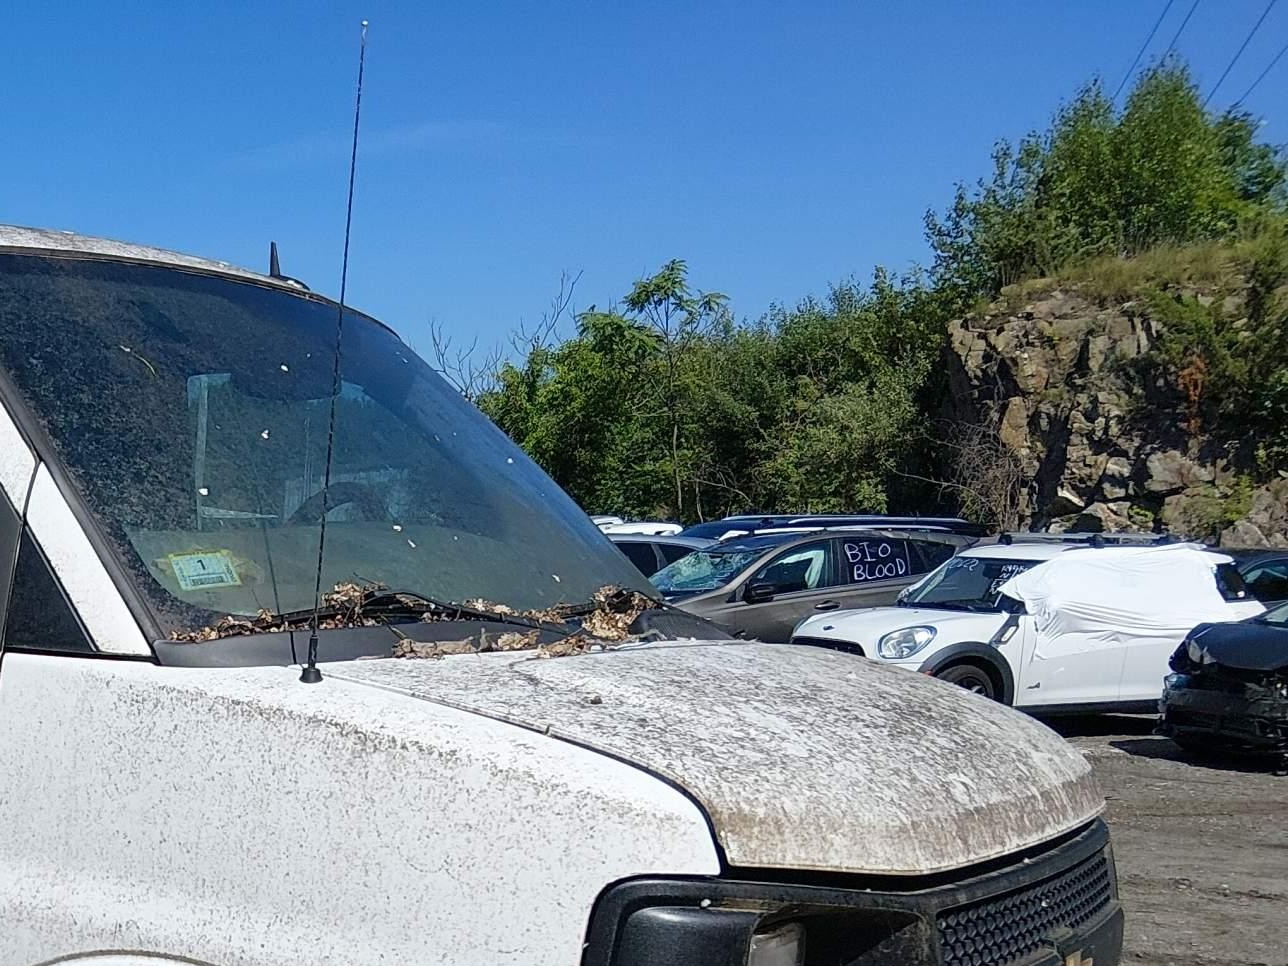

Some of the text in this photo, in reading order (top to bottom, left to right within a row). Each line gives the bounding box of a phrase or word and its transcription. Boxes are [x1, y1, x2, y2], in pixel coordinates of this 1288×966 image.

[844, 541, 891, 563] BIO
[196, 559, 206, 571] 1
[854, 558, 906, 581] BLOOD
